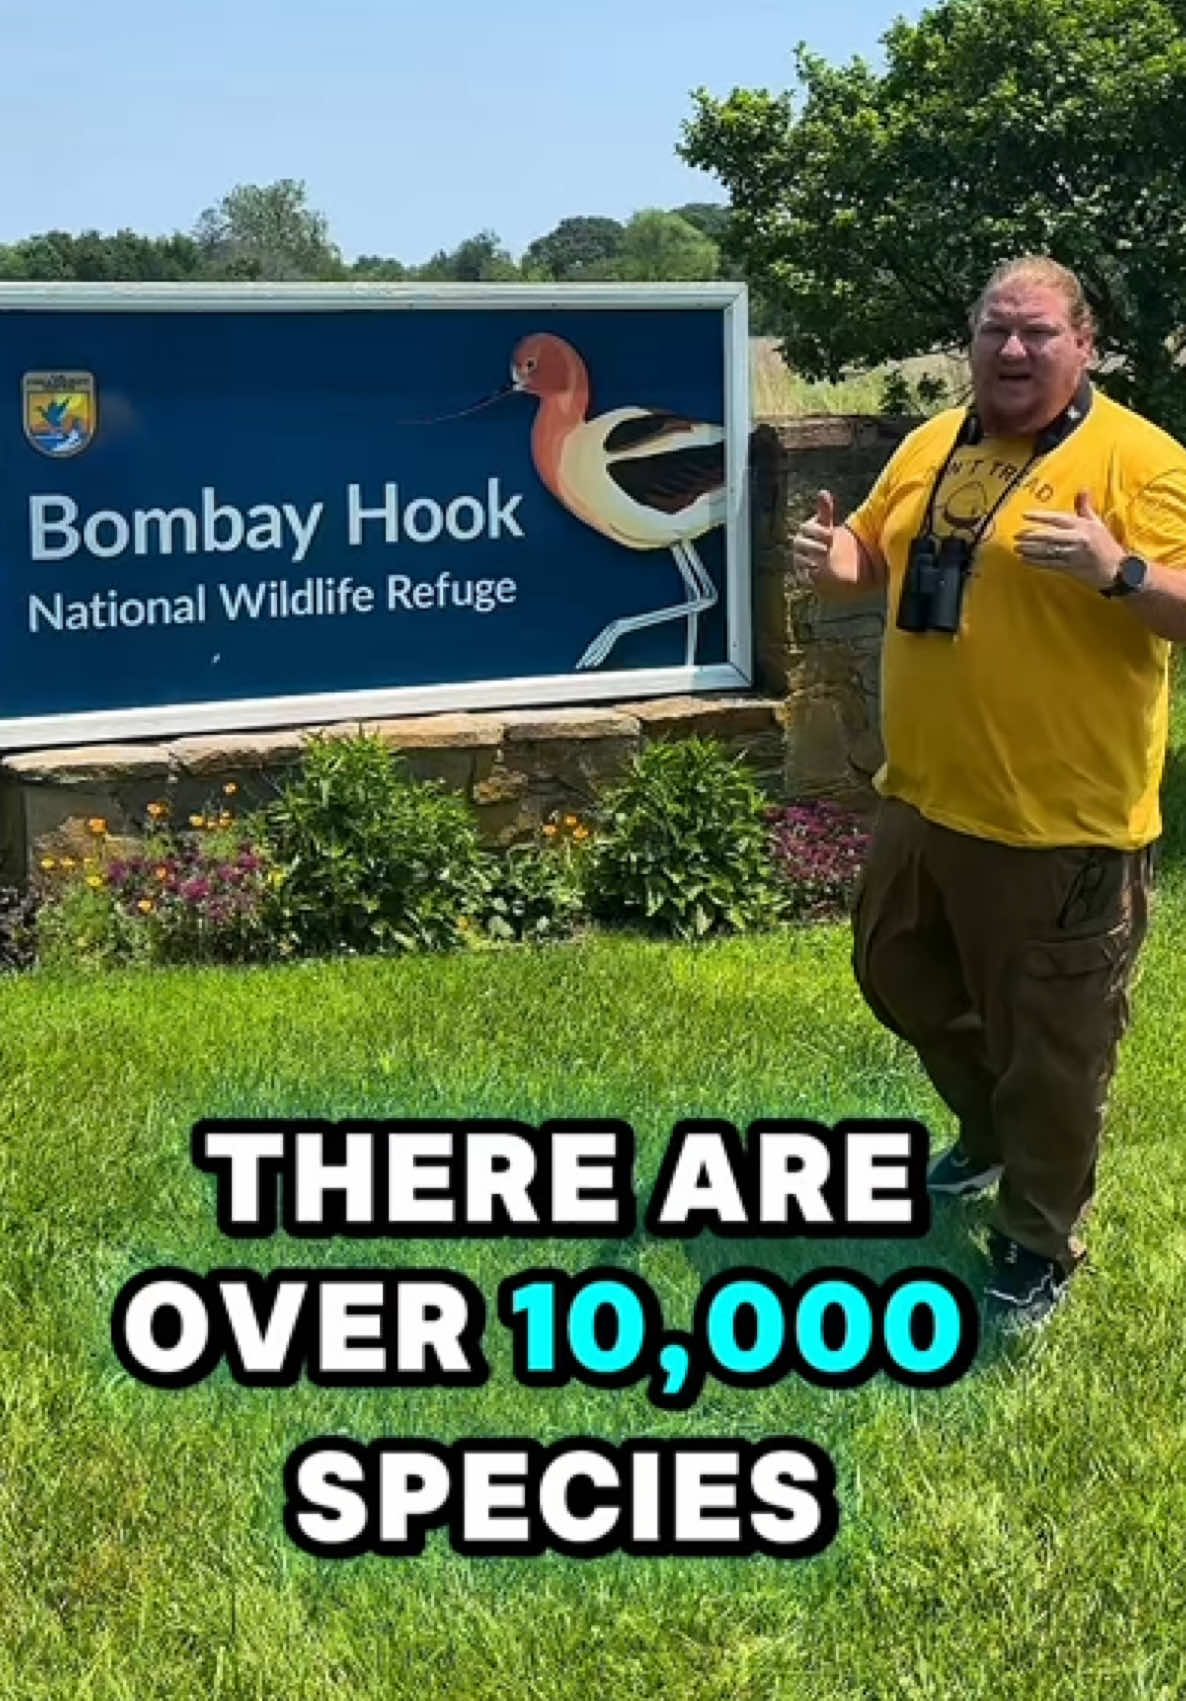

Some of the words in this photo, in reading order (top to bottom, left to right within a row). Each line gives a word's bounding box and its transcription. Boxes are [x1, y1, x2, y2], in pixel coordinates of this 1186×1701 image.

[29, 486, 323, 561] Bombay
[347, 478, 524, 545] Hook
[29, 584, 206, 633] National
[219, 577, 375, 621] Wildlife
[387, 571, 517, 612] Refuge
